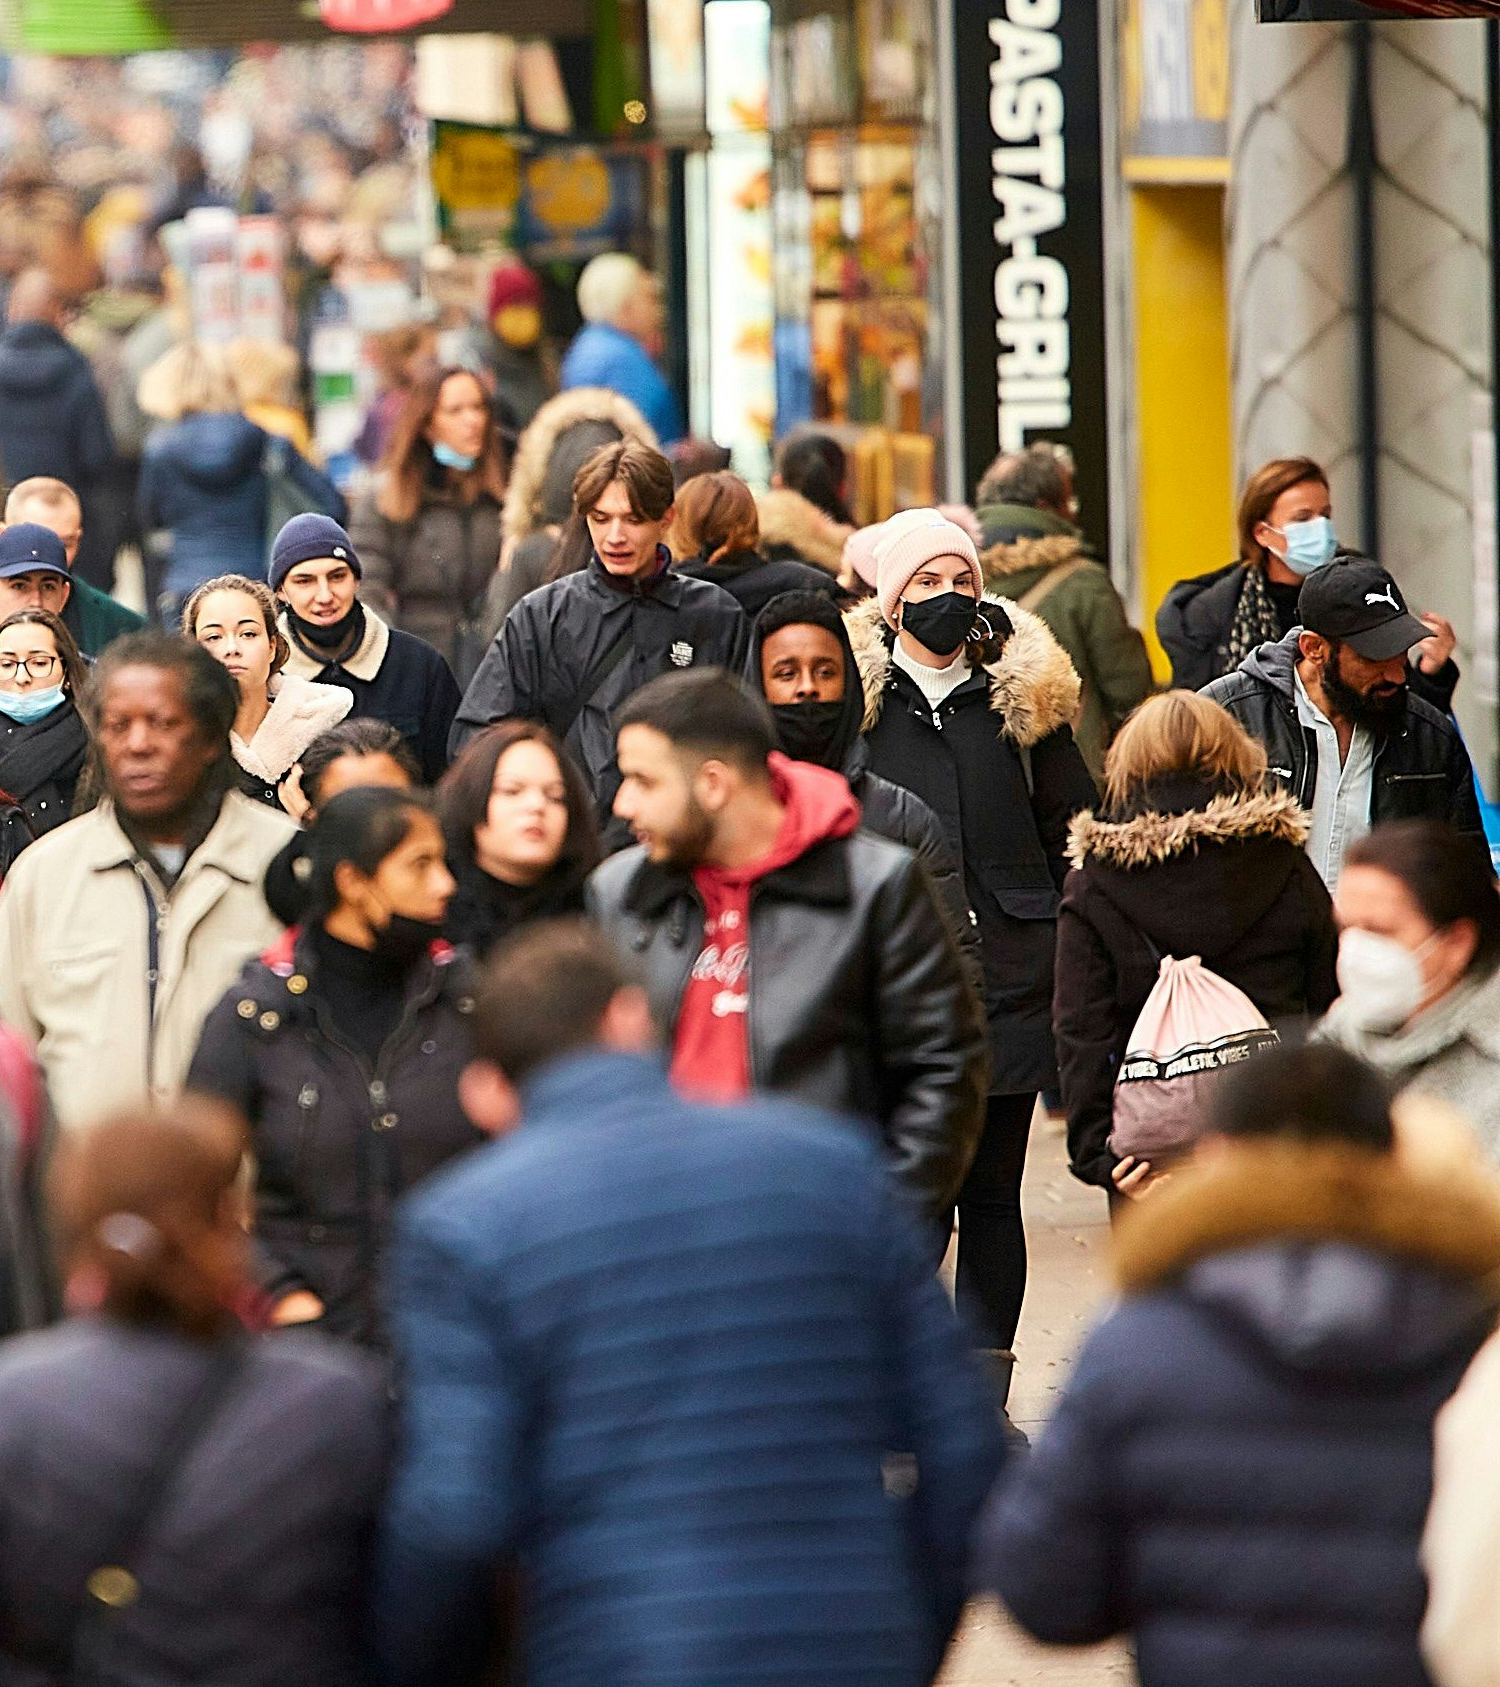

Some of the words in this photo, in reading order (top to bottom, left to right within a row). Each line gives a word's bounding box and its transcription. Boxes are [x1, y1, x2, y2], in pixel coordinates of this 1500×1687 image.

[1128, 1061, 1159, 1079] VIBES
[1165, 1050, 1218, 1078] ATHLETIC
[1217, 1044, 1250, 1066] VIBES
